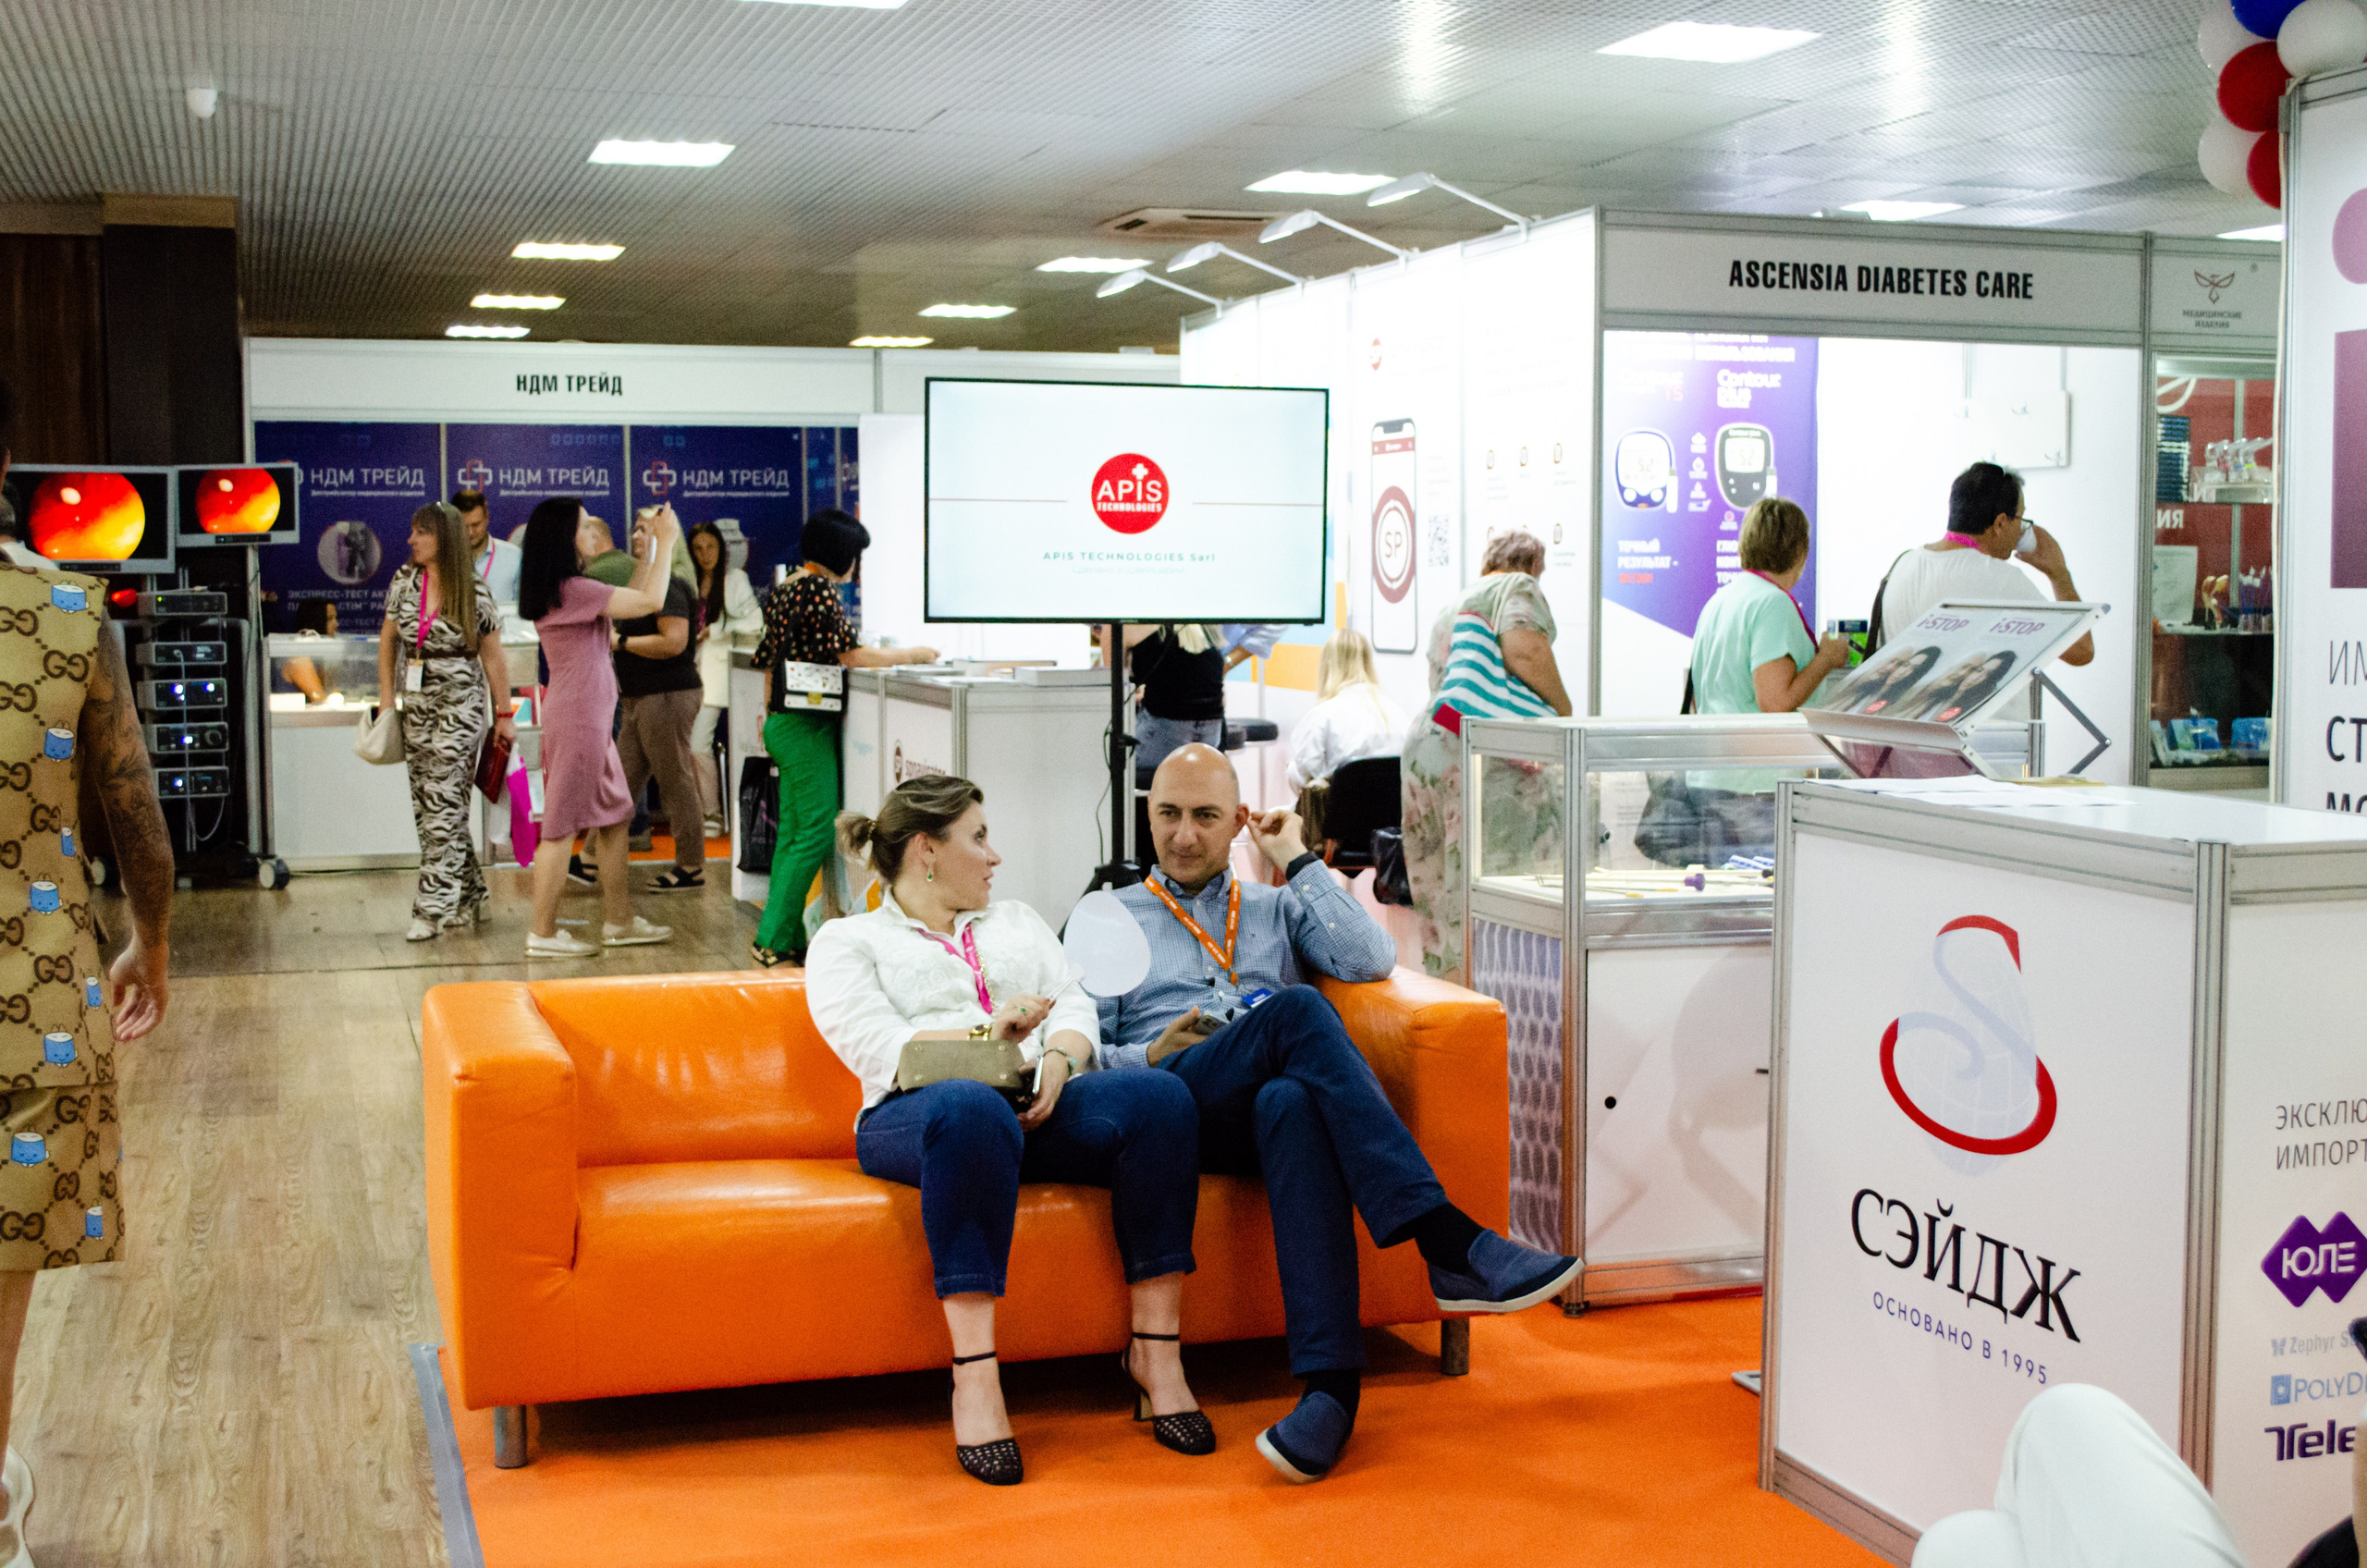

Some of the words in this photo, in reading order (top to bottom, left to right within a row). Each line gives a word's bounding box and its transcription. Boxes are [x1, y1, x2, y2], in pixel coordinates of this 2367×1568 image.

[1728, 260, 1848, 292] ASCENSIA
[1857, 264, 1968, 297] DIABETES
[1975, 270, 2034, 300] CARE
[516, 374, 558, 395] НДМ
[566, 372, 623, 396] ТРЕЙД
[311, 467, 355, 487] НДМ
[362, 465, 425, 488] ТРЕЙД
[499, 467, 542, 487] НДМ
[547, 465, 610, 487] ТРЕЙД
[682, 469, 724, 488] НДМ
[730, 467, 790, 488] ТРЕЙД
[1043, 551, 1074, 560] APIS
[1080, 551, 1184, 561] TECHNOLOGIES
[2325, 715, 2367, 763] СТ
[2275, 1098, 2367, 1130] ЭКСКЛЮ
[1850, 1187, 2081, 1344] СЭЙДЖ
[1872, 1291, 1973, 1352] ОСНОВАНО
[1981, 1339, 1992, 1359] В
[2002, 1348, 2047, 1385] 1995
[2289, 1334, 2336, 1356] Zephyr
[2294, 1372, 2367, 1403] POLYD
